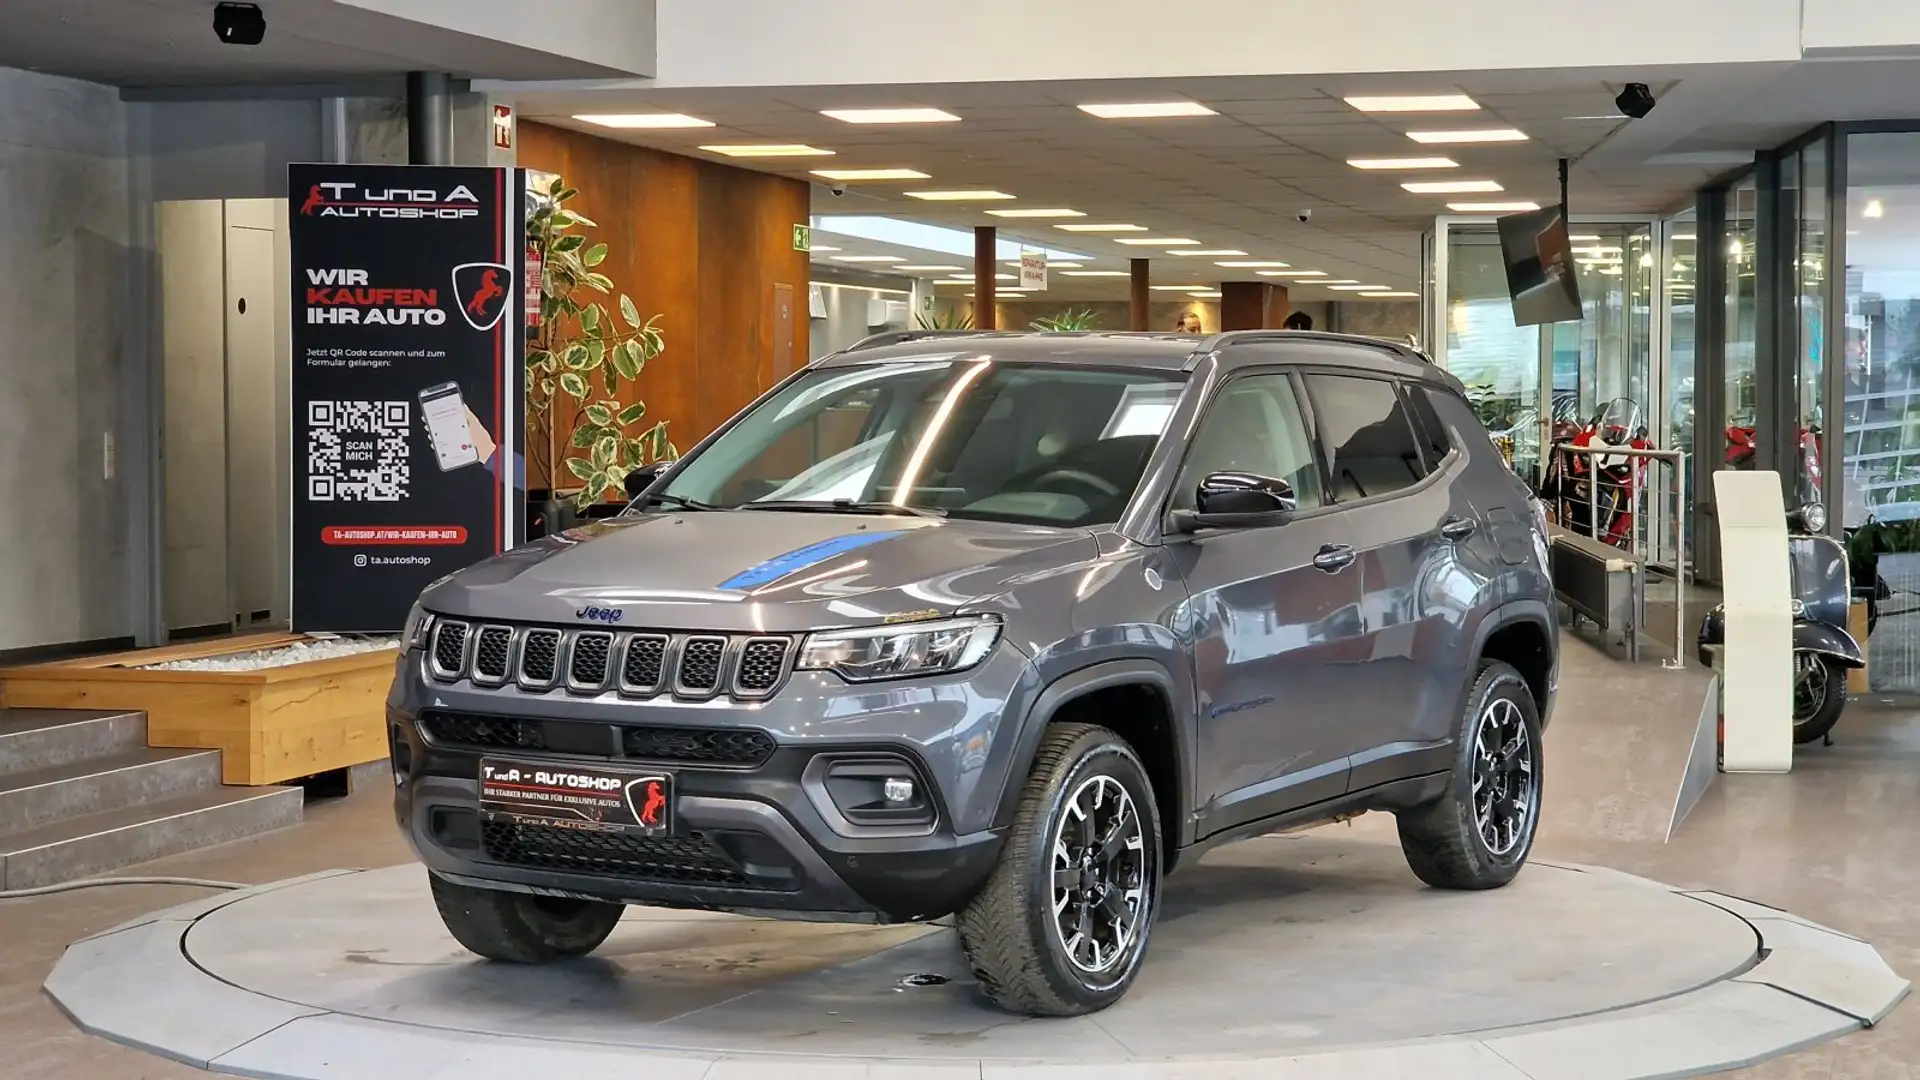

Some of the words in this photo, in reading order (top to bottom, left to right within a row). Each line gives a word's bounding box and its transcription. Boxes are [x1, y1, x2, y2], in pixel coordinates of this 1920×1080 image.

[320, 182, 356, 200] T
[444, 184, 479, 203] A
[320, 206, 479, 219] AUTOSHOP
[306, 268, 369, 286] WIR
[307, 288, 437, 306] KAUFEN
[307, 307, 360, 325] IHR
[362, 308, 447, 326] AUTO
[306, 348, 328, 357] Jetzt
[329, 348, 344, 357] QR
[345, 348, 368, 357] Code
[369, 349, 406, 358] scannen
[407, 349, 425, 358] und
[426, 350, 446, 358] zum
[307, 358, 346, 367] Formular
[348, 359, 392, 369] gelangen:
[346, 441, 373, 451] SCAN
[346, 451, 373, 461] MICH
[370, 555, 431, 566] ta.autoshop
[576, 605, 623, 624] Jeep
[535, 771, 621, 791] AUTOSHOP
[521, 792, 550, 801] PARTNER
[598, 799, 621, 808] AUTOS
